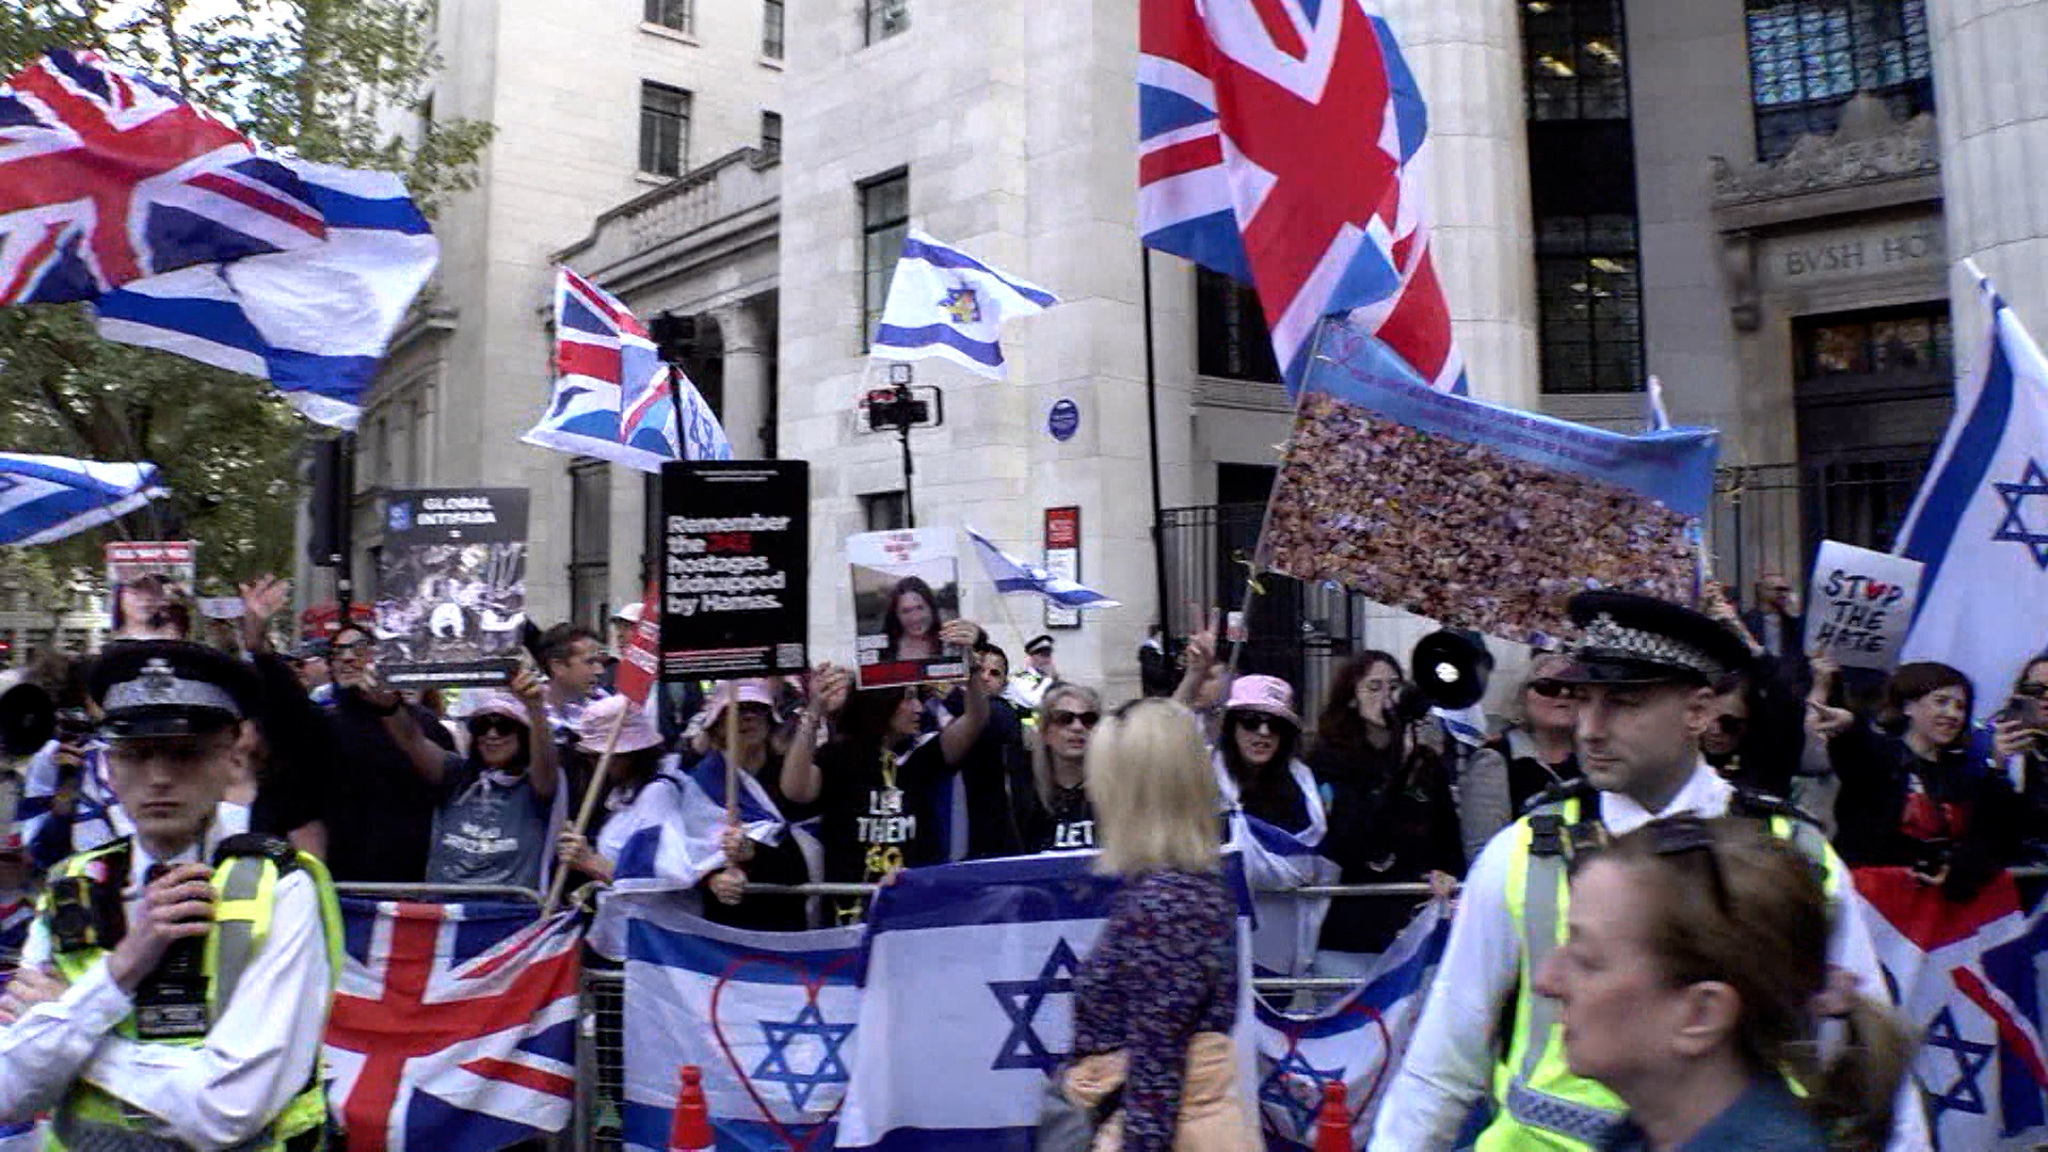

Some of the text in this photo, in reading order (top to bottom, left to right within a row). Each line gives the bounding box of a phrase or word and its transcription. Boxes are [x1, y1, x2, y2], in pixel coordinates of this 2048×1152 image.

[1786, 242, 1863, 276] BVSH
[667, 513, 791, 533] Remember
[667, 534, 707, 554] the
[667, 554, 769, 574] hostages
[667, 571, 786, 595] kidnapped
[667, 594, 700, 617] by
[1832, 600, 1886, 630] THE
[1816, 623, 1887, 653] HATE
[856, 815, 917, 843] THEM
